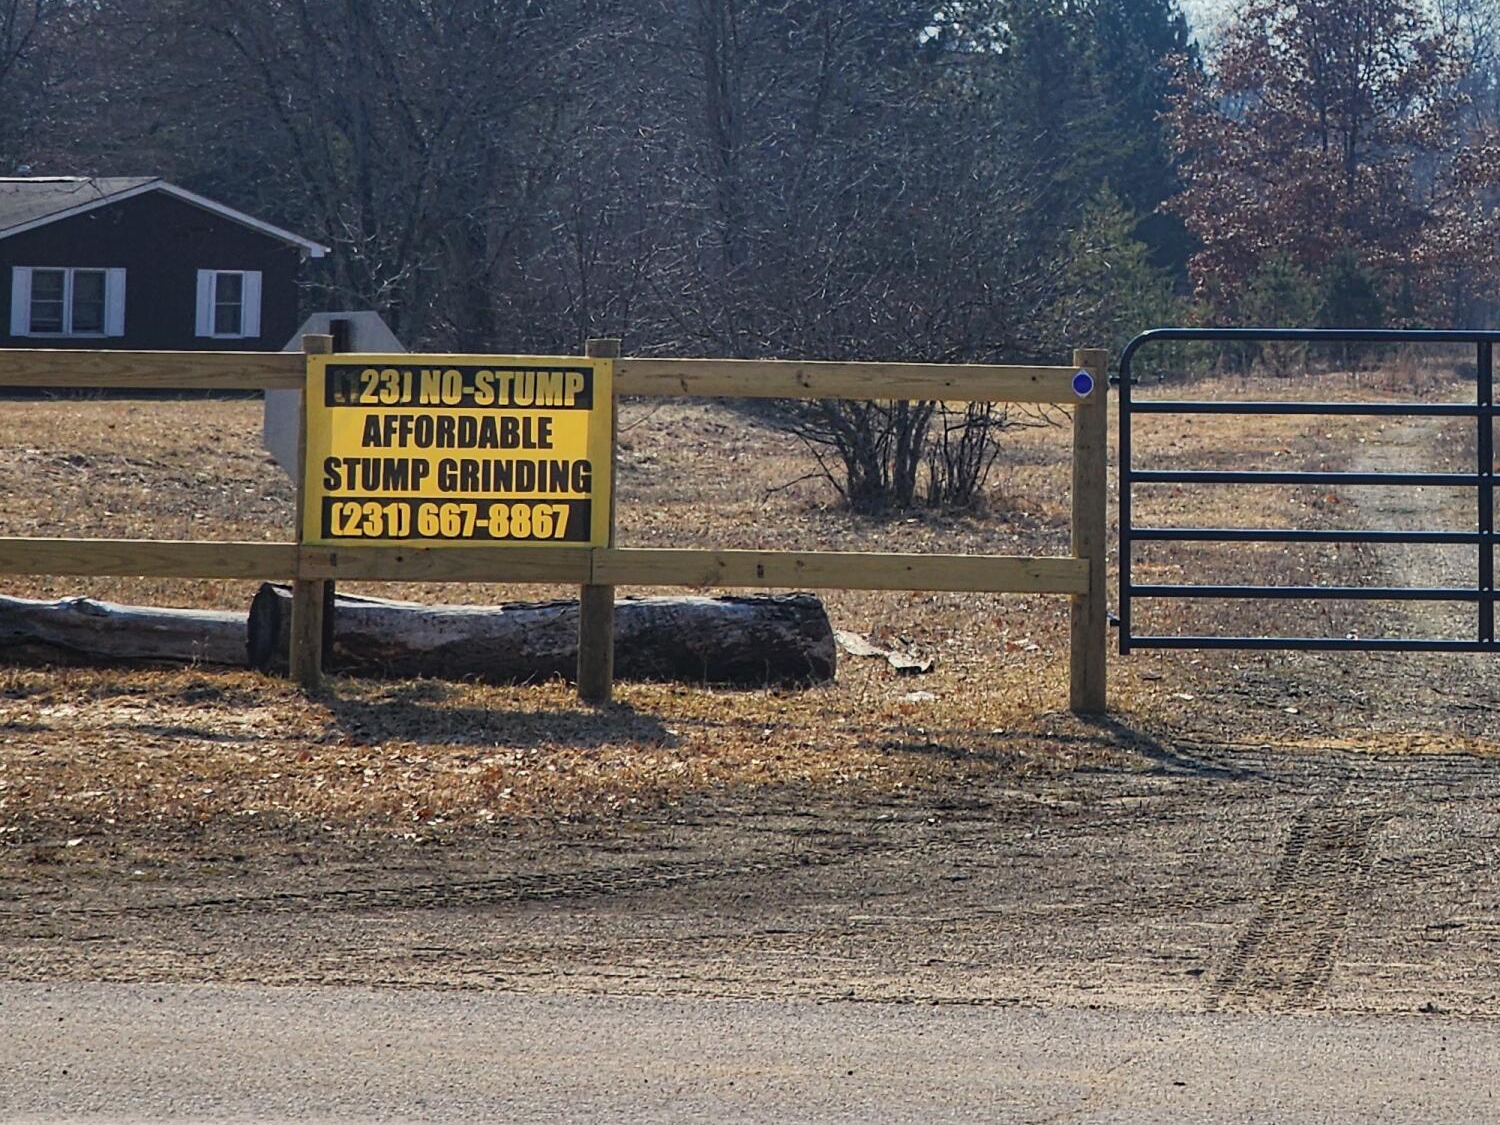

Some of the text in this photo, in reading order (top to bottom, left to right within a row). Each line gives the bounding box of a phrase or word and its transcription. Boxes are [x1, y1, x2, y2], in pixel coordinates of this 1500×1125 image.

[419, 370, 584, 407] NO-STUMP
[361, 415, 553, 449] AFFORDABLE
[323, 457, 592, 493] STUMP GRINDING
[331, 502, 570, 539] (231) 667-8867
